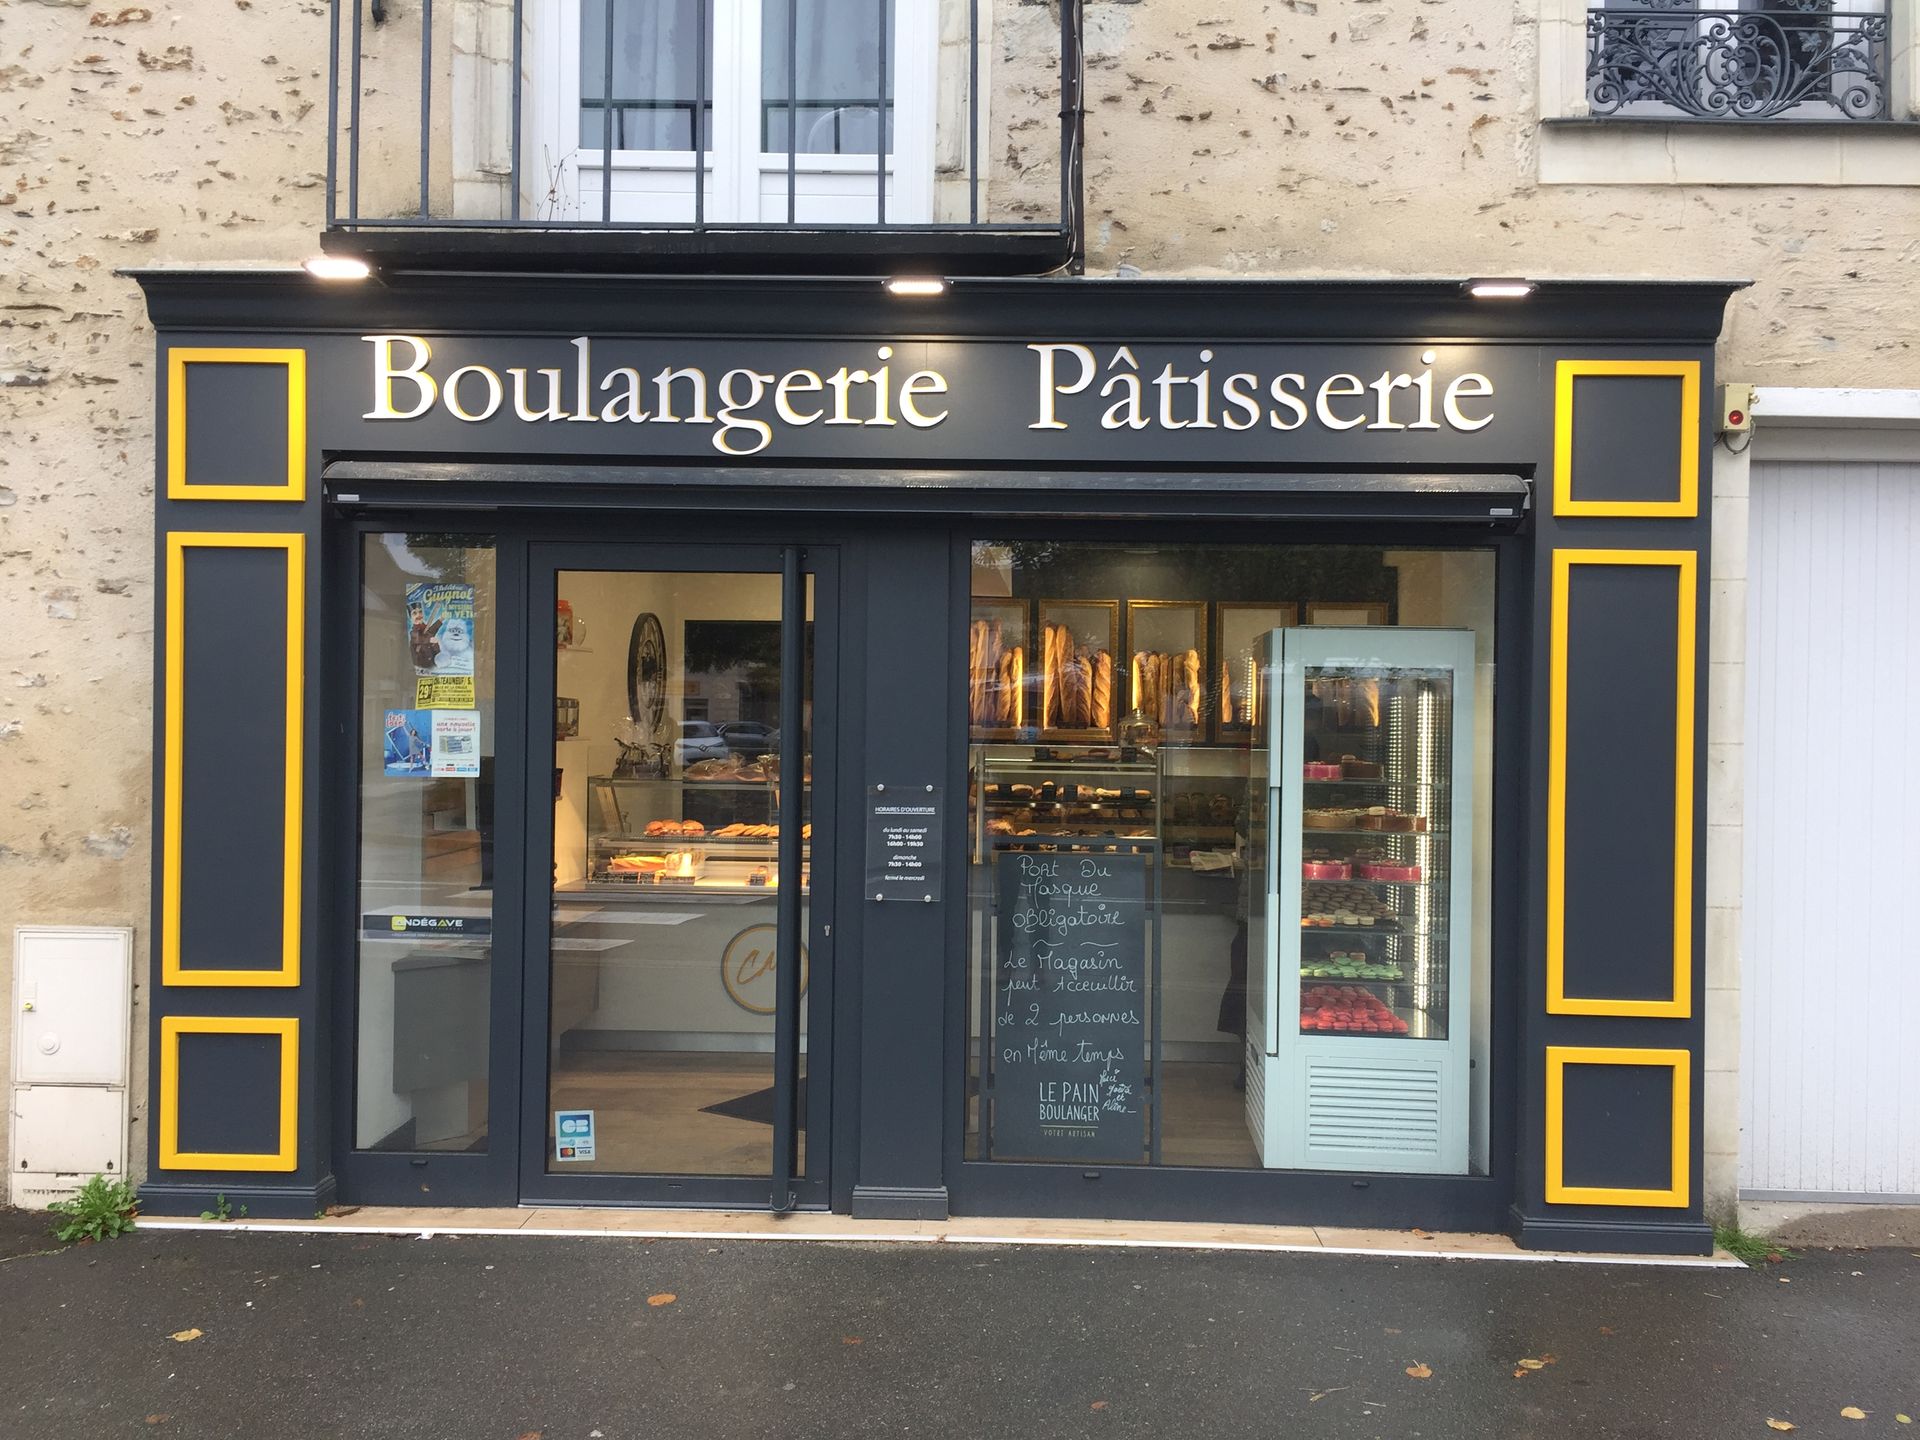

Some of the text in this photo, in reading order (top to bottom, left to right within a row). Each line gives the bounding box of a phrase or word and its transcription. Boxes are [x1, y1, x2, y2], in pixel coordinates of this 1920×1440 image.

[361, 335, 1494, 455] Boulangerie Pâtisserie
[423, 588, 474, 607] Guignol
[1080, 859, 1112, 877] Du
[1021, 877, 1101, 908] Masque
[1004, 950, 1123, 980] Le Magasin
[998, 1012, 1015, 1026] de
[1025, 1003, 1040, 1025] 2
[1003, 1048, 1022, 1063] en
[1072, 1040, 1124, 1071] temps
[1039, 1082, 1057, 1102] LE
[1062, 1082, 1099, 1103] PAIN
[1039, 1104, 1100, 1122] BOULANGER
